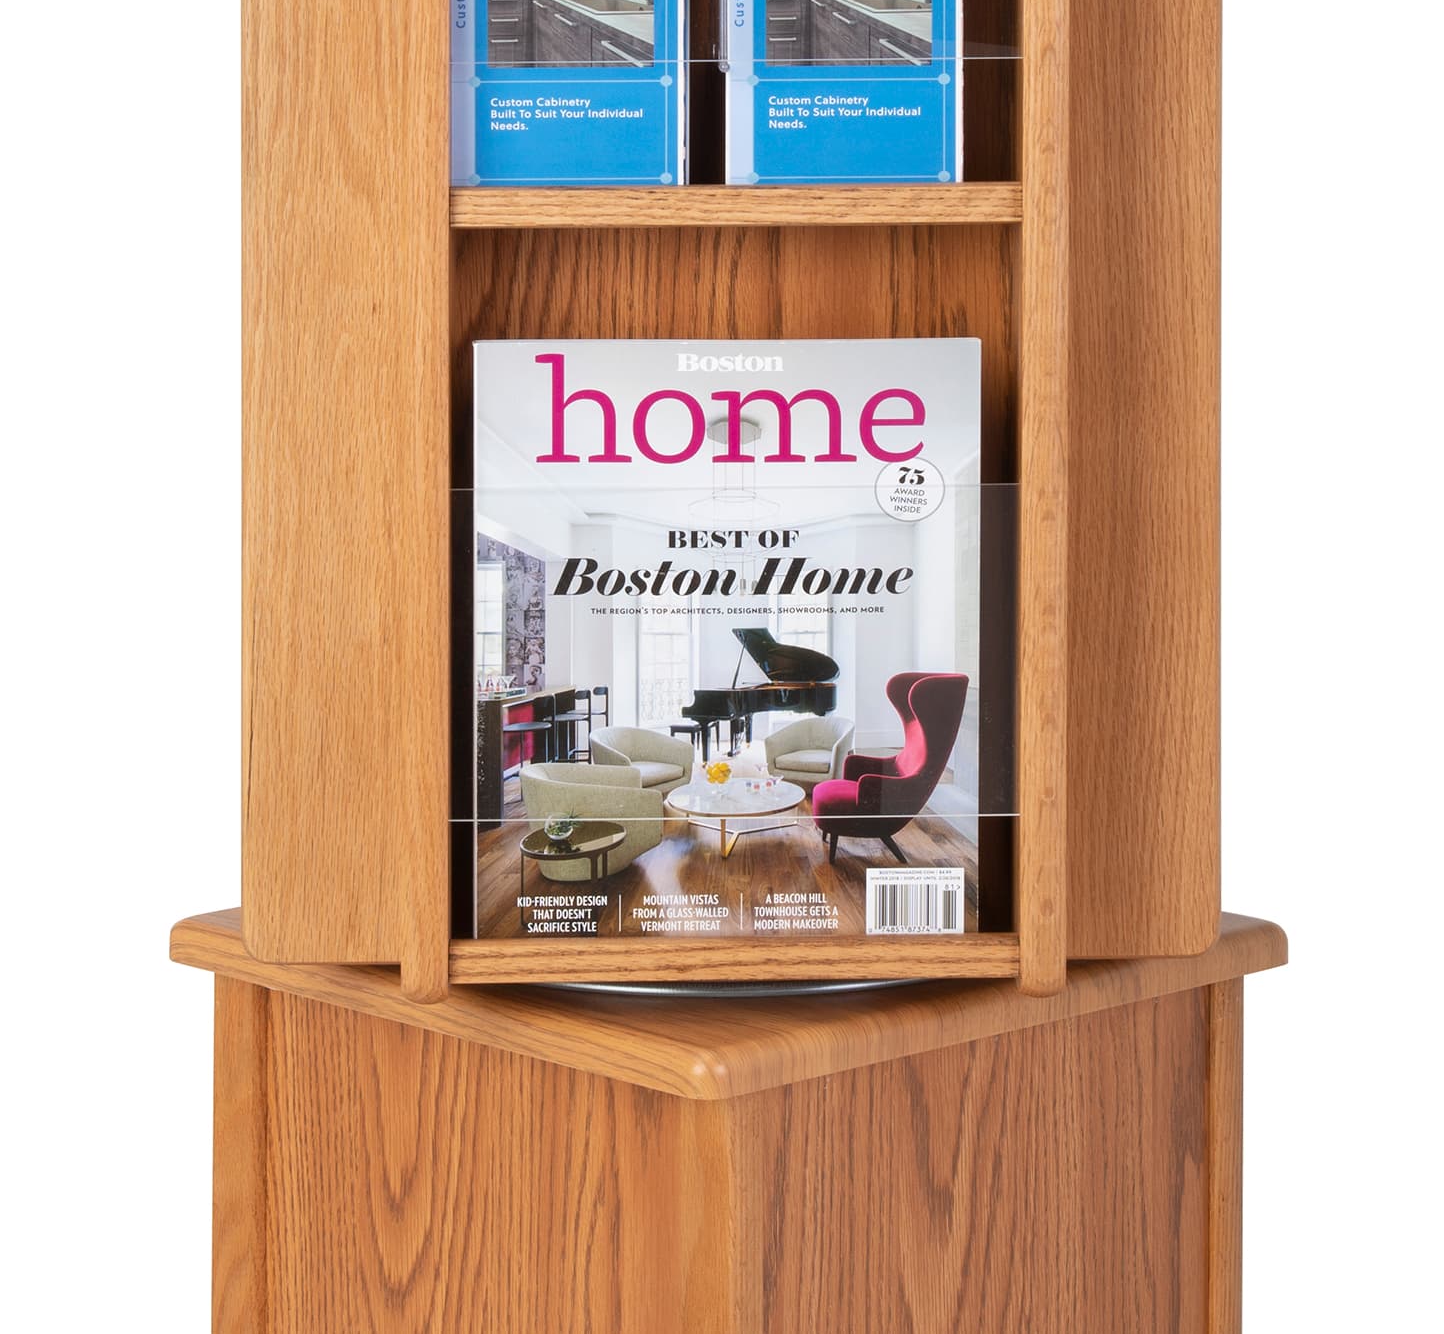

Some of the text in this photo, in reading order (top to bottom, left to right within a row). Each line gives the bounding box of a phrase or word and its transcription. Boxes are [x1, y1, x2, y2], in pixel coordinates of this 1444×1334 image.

[490, 97, 591, 108] Custom Cabinetry
[768, 95, 869, 106] Custom Cabinetry
[490, 108, 643, 119] Built To Suit Your Individual
[768, 107, 921, 117] Built To Suit Your Individual
[490, 121, 529, 131] Needs.
[768, 119, 807, 129] Needs.
[676, 352, 784, 372] Boston
[534, 353, 927, 464] home
[899, 466, 925, 485] 75
[894, 488, 925, 497] AWARD
[889, 496, 928, 506] WINNERS
[894, 505, 921, 514] INSIDE
[667, 529, 801, 549] BEST OF
[552, 557, 914, 597] Boston Home
[609, 607, 649, 615] REGION'S
[670, 607, 725, 615] ARCHITECTS,
[727, 607, 776, 615] DESIGNERS,
[517, 895, 608, 907] KID-FRIENDLY DESIGN
[643, 894, 719, 906] MOUNTAIN VISTAS
[765, 893, 827, 904] A BEACON HILL
[532, 908, 592, 920] THAT DOESN'T
[633, 907, 729, 919] FROM A GLASS-WALLED
[754, 905, 839, 917] TOWNHOUSE GETS A
[527, 921, 597, 933] SACRIFICE STYLE
[641, 920, 721, 932] VERMONT RETREAT
[754, 918, 839, 930] MODERN MAKEOVER
